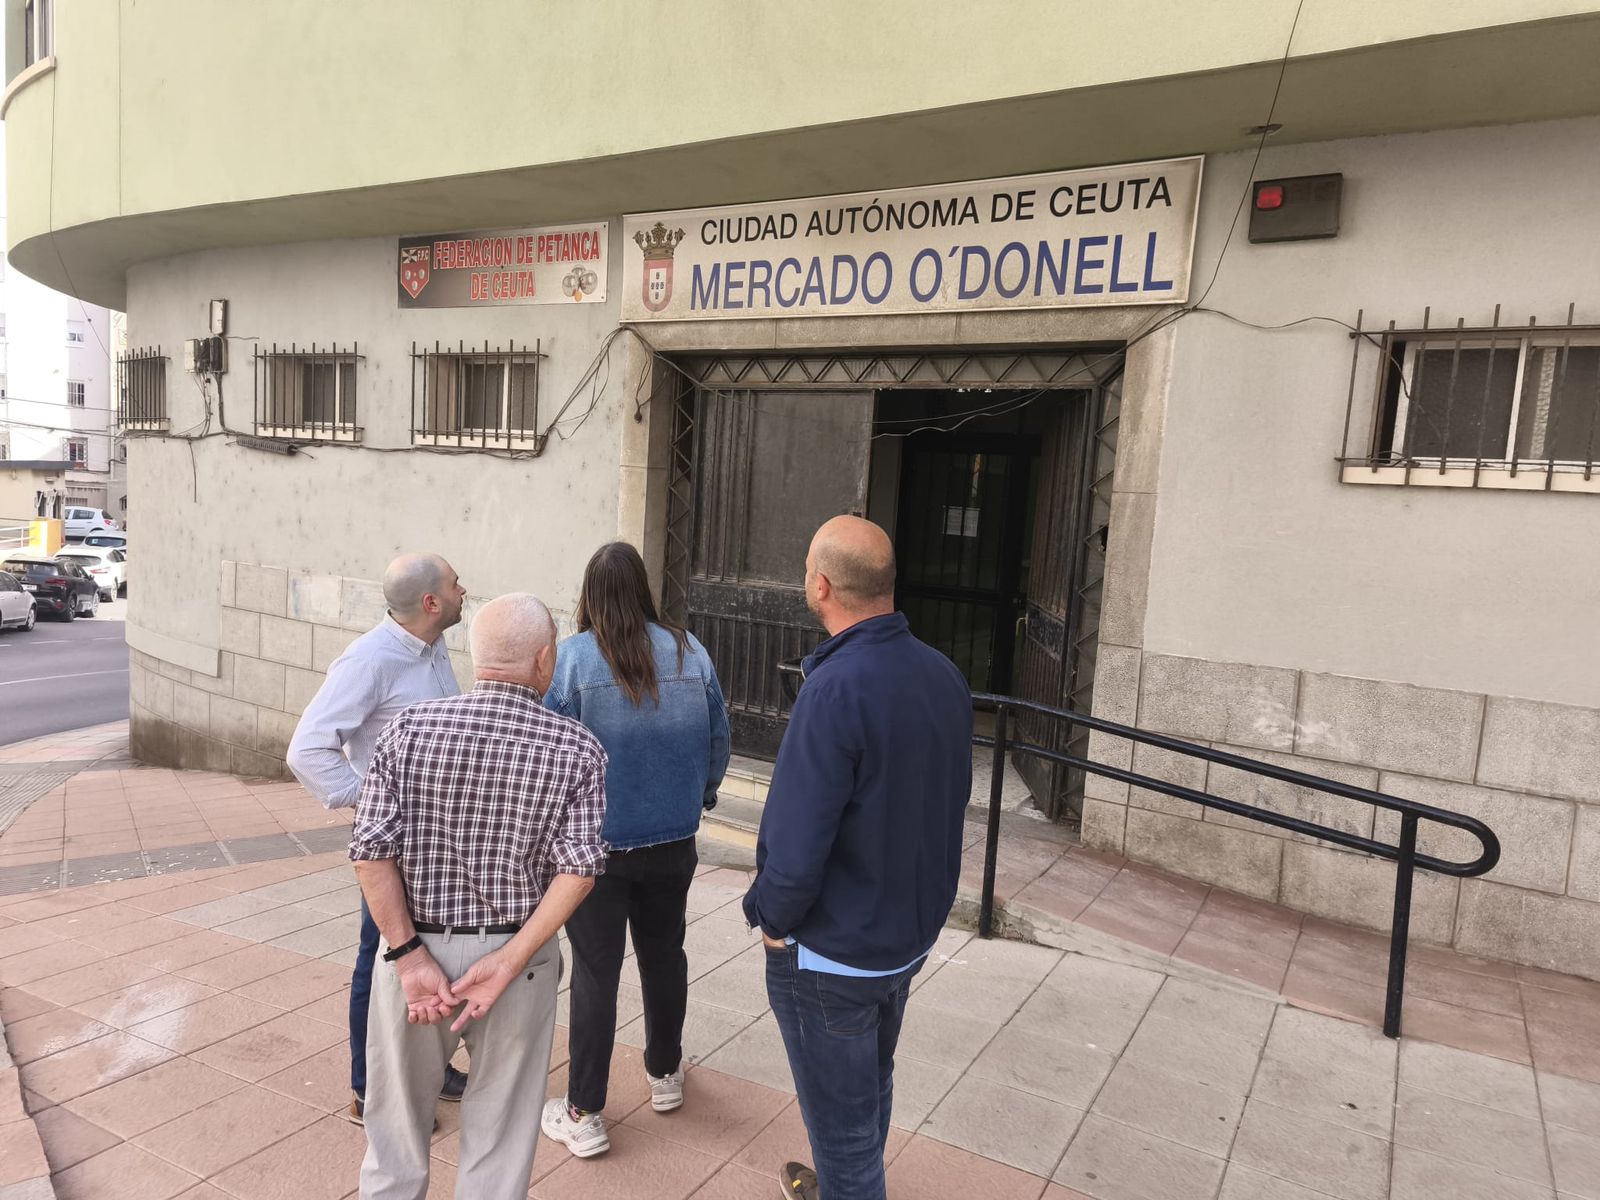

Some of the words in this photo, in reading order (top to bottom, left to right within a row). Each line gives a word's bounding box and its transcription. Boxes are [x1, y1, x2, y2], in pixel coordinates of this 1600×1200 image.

[701, 213, 798, 245] CIUDAD
[805, 198, 979, 237] AUTÓNOMA
[990, 190, 1036, 223] DE
[1050, 176, 1172, 218] CEUTA
[433, 236, 513, 270] FEDERACION
[517, 236, 534, 265] DE
[537, 230, 600, 263] PETANCA
[470, 272, 489, 300] DE
[491, 270, 535, 300] CEUTA
[690, 251, 893, 310] MERCADO
